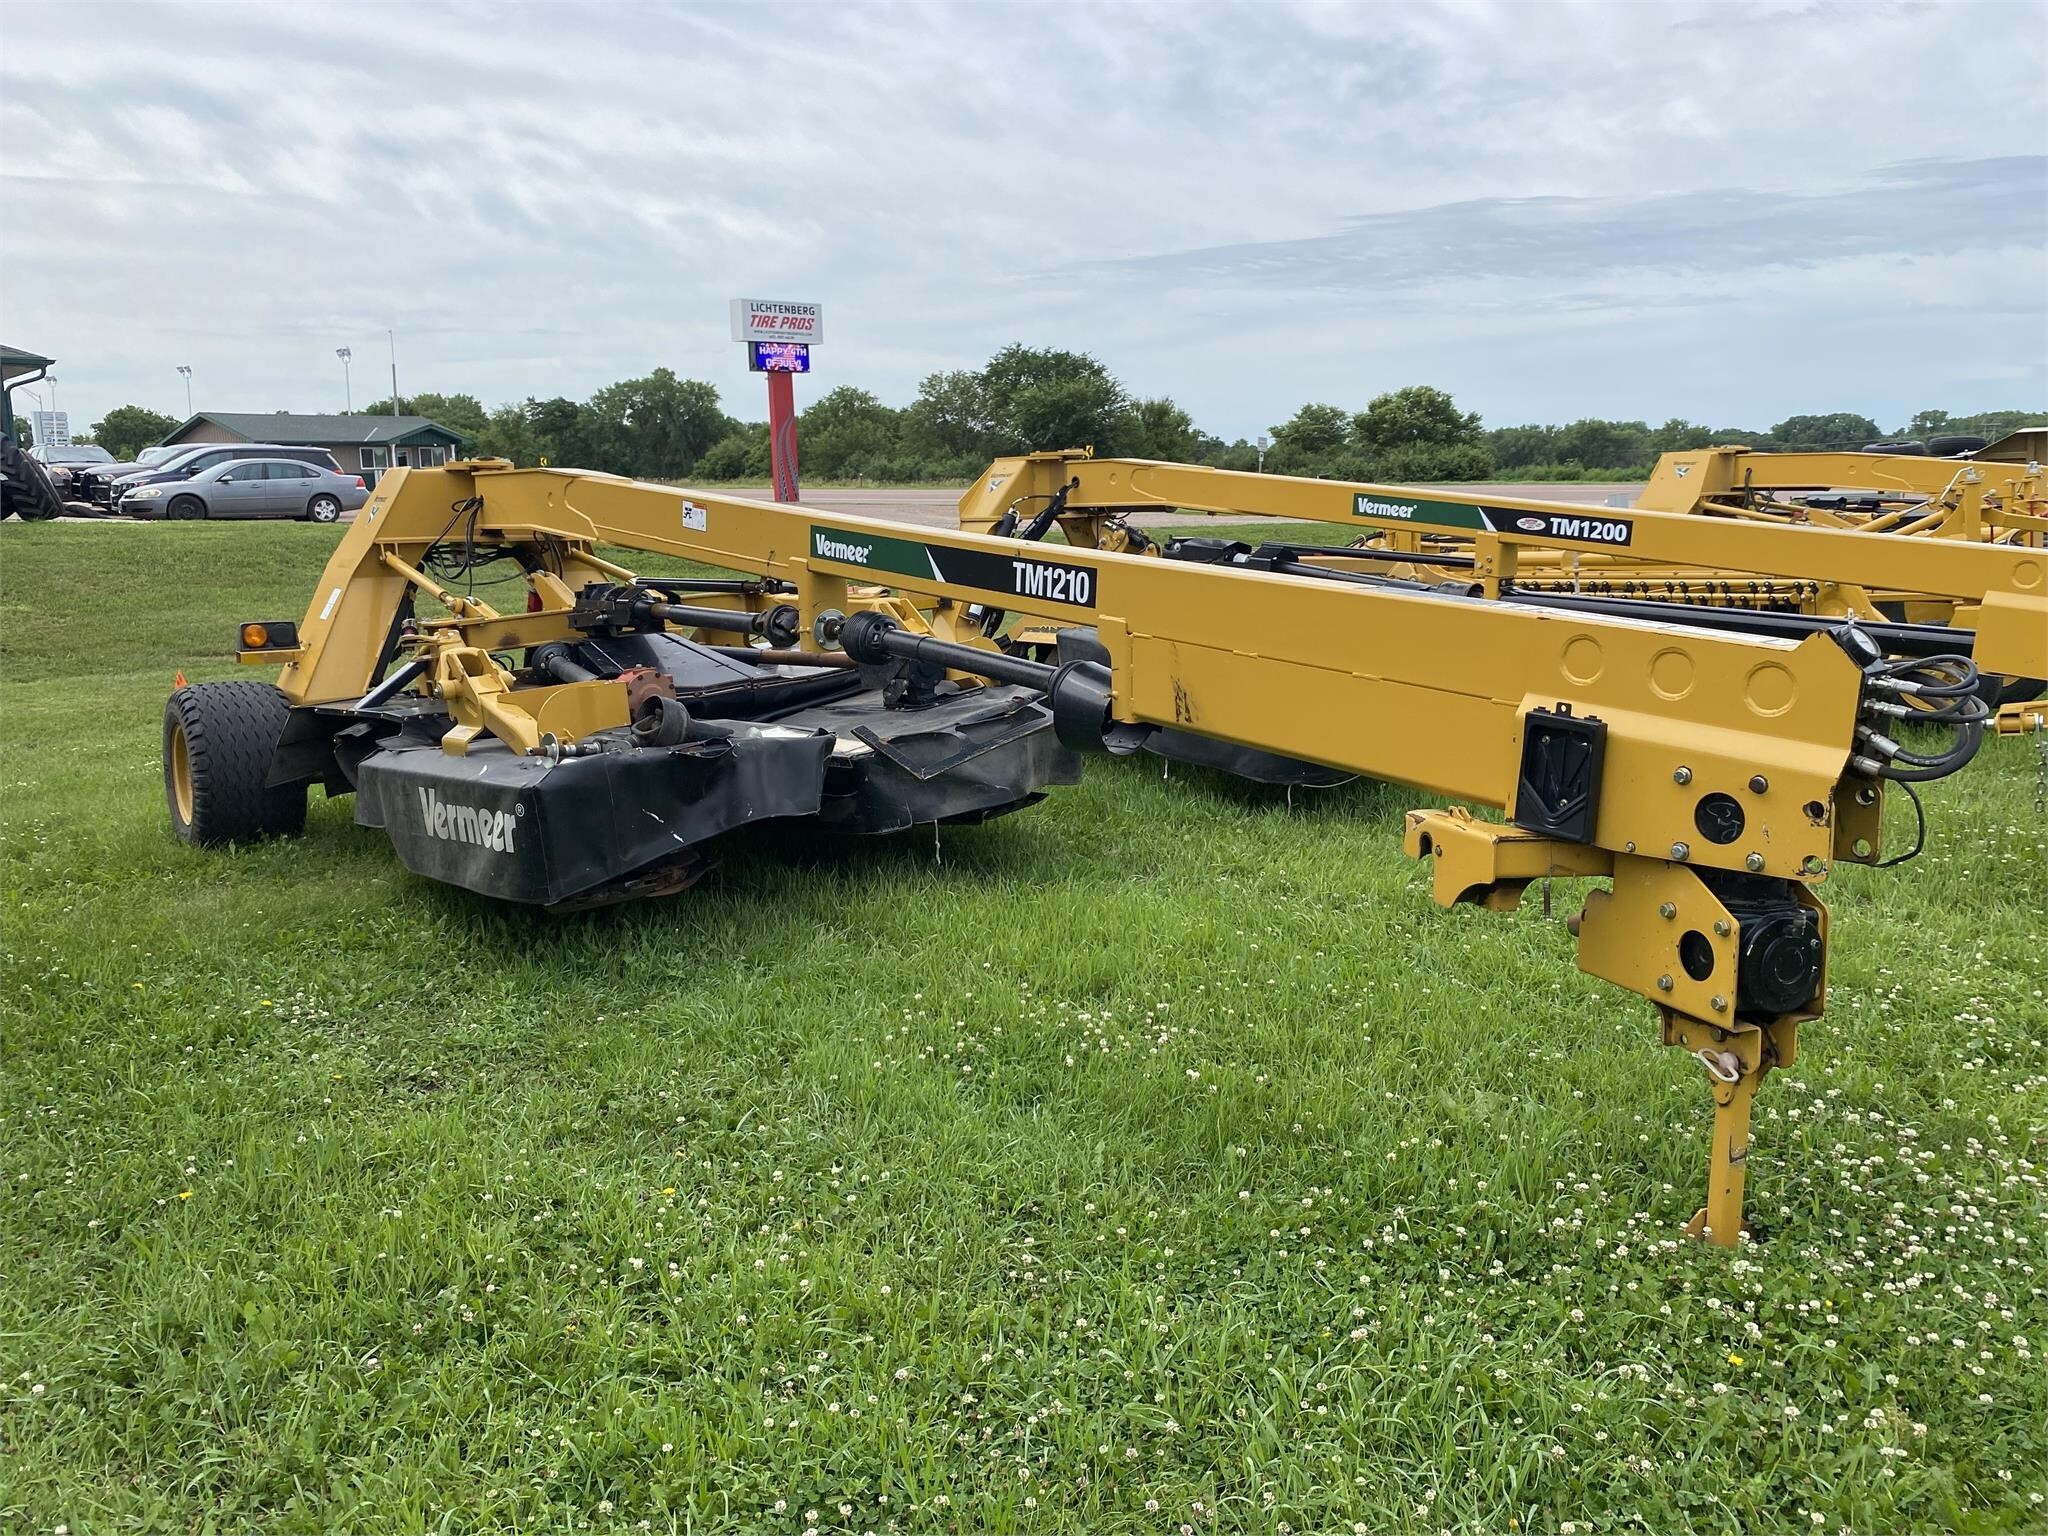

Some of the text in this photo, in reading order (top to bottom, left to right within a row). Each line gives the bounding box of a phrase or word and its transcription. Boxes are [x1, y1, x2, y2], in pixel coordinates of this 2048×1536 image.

[750, 302, 816, 316] LICHTENBERG
[750, 314, 815, 331] TIRE PROS
[759, 346, 807, 356] HAPPY 4TH
[1357, 497, 1414, 519] Vermeer
[1550, 517, 1627, 542] TM1200
[815, 533, 1090, 604] Vermeer TM1210
[418, 786, 517, 854] Vermeer
